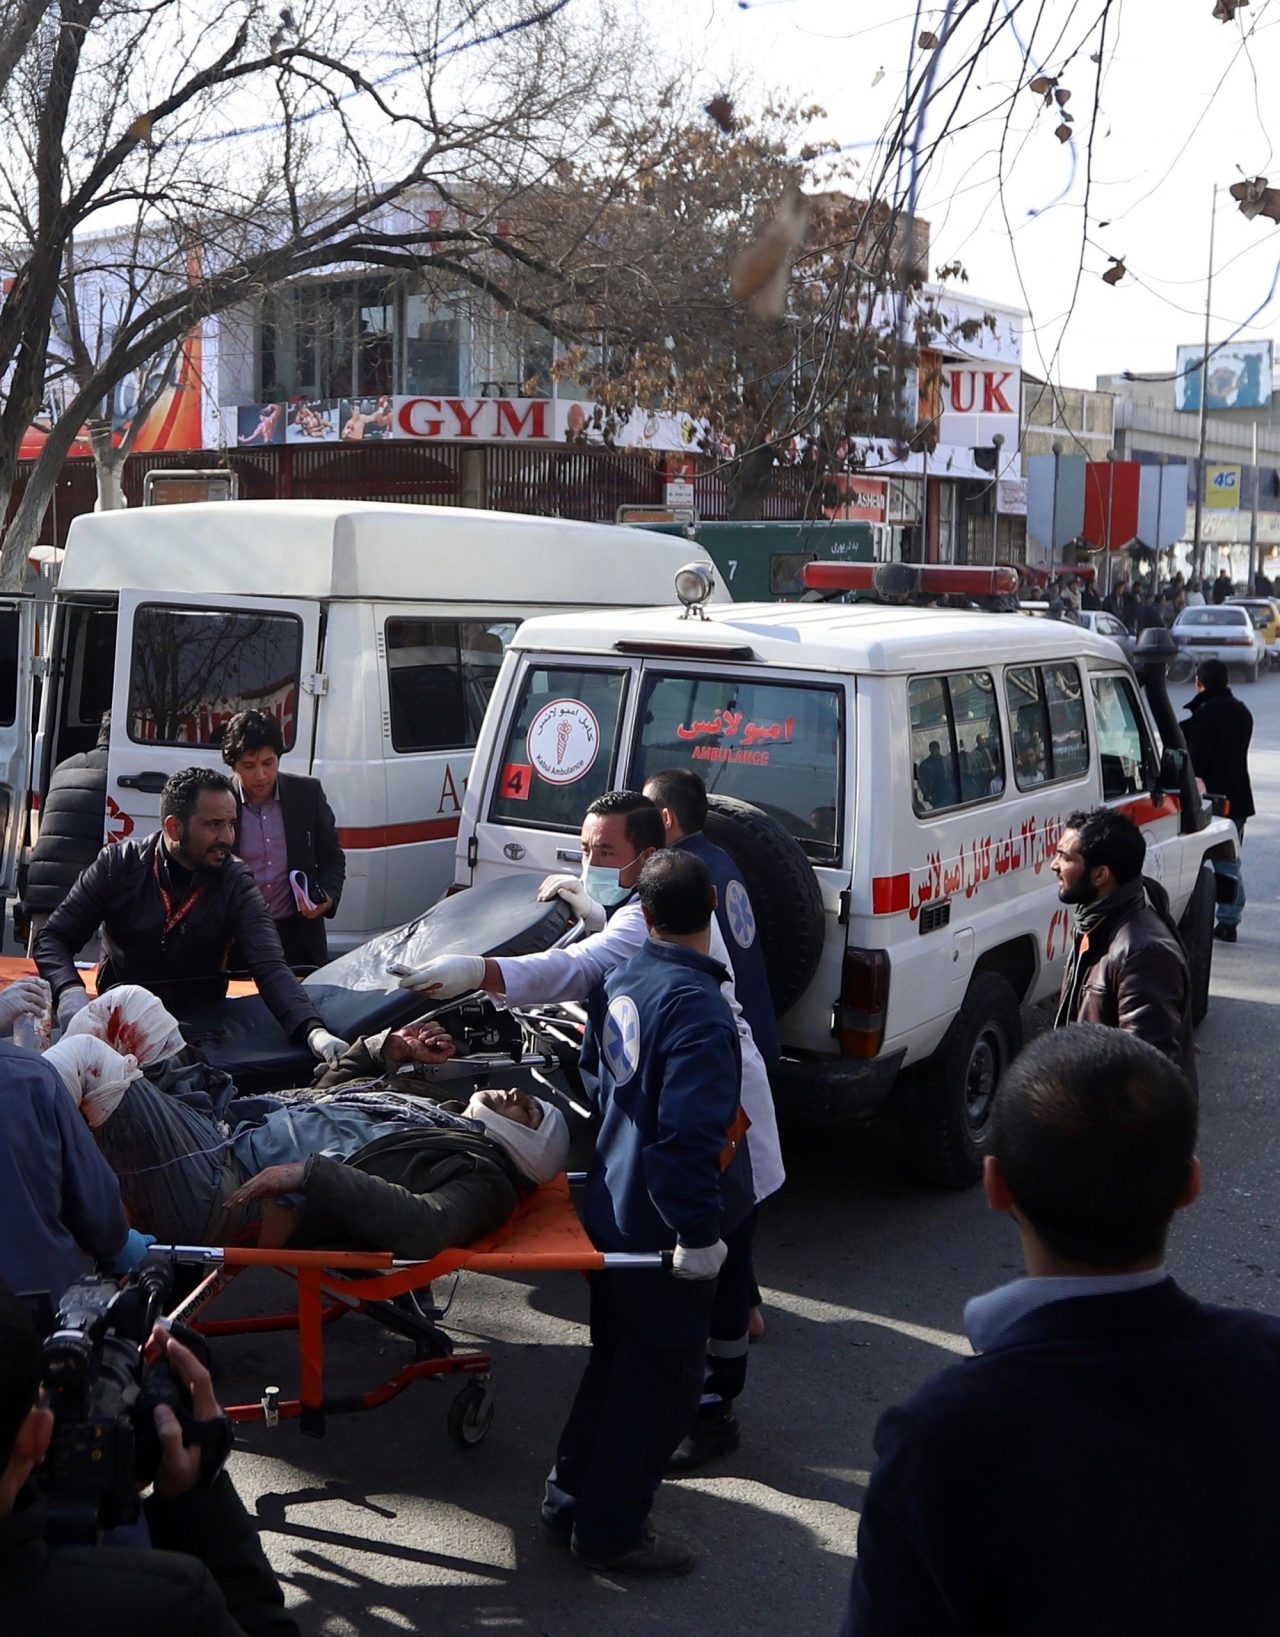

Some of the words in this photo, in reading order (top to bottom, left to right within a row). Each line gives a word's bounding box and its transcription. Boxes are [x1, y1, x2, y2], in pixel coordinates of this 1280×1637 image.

[949, 370, 1014, 412] UK
[397, 398, 551, 438] GYM
[1213, 471, 1237, 487] 4G
[728, 560, 738, 580] 7
[692, 745, 770, 766] AMBULANCE
[550, 759, 585, 776] Ambulance
[507, 770, 524, 794] 4
